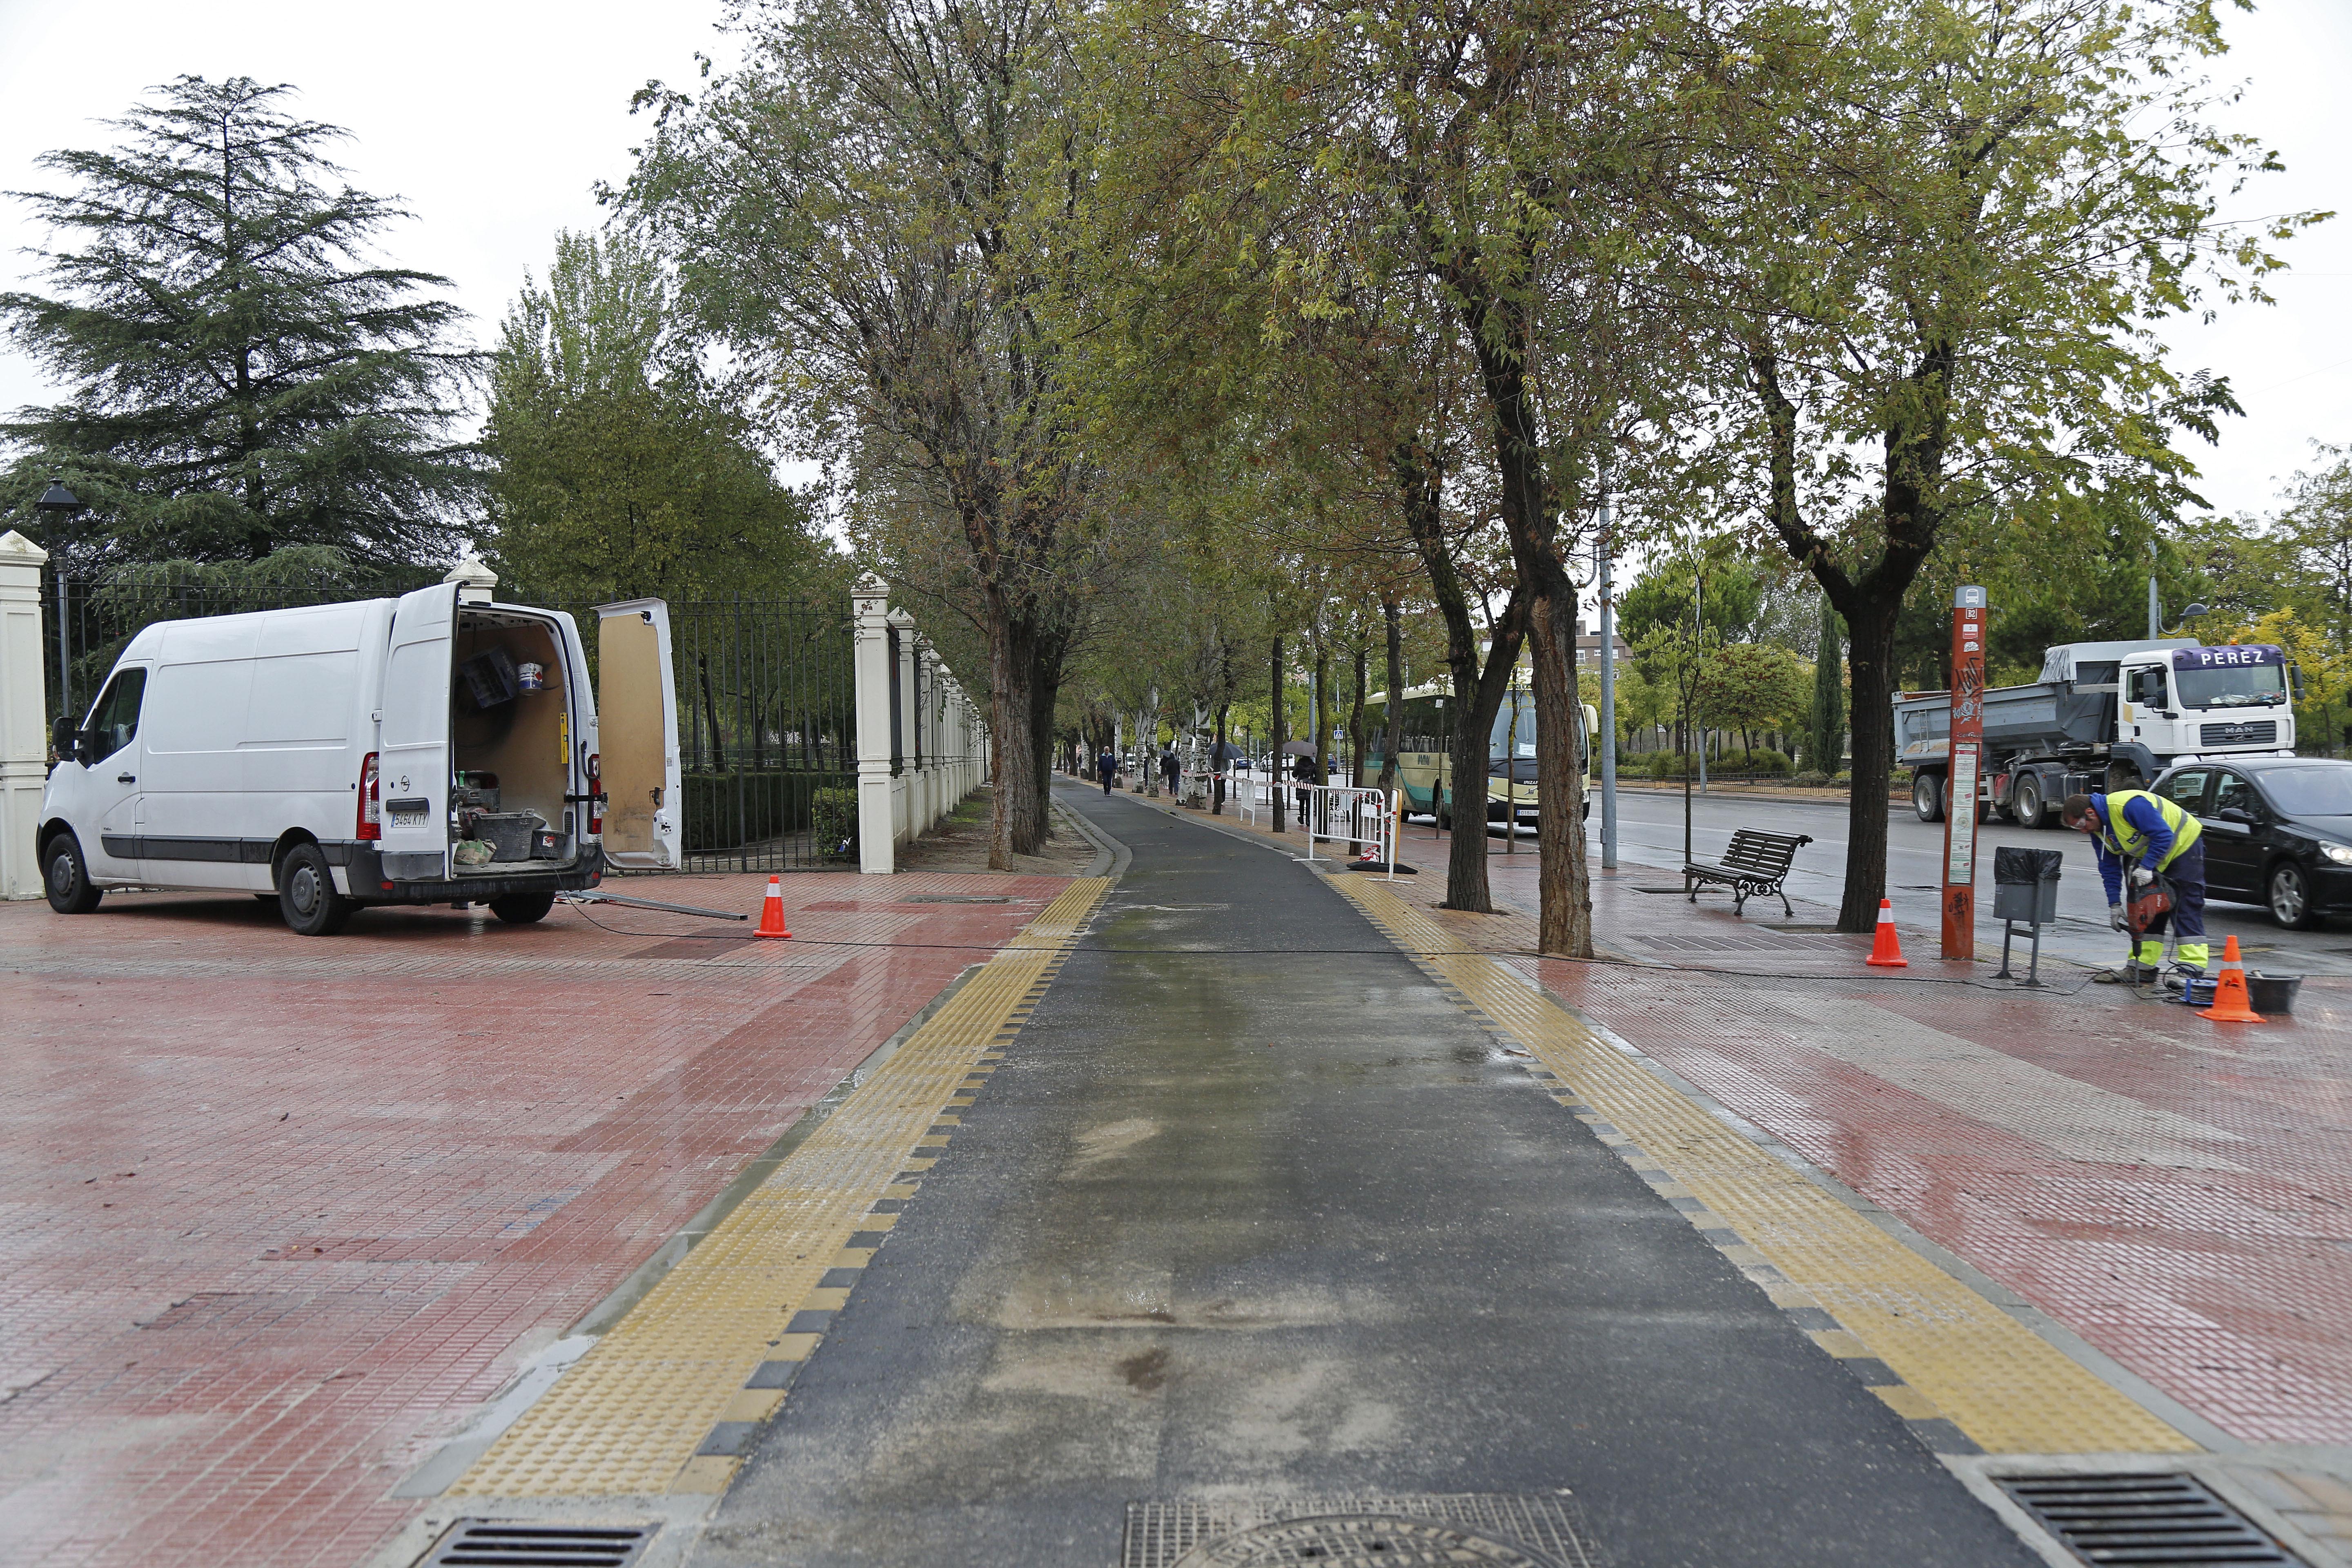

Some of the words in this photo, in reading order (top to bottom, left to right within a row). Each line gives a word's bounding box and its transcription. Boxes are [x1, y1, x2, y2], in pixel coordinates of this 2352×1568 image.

[2201, 651, 2265, 665] PEREZ
[395, 813, 412, 825] 5464
[412, 813, 428, 825] KTY
